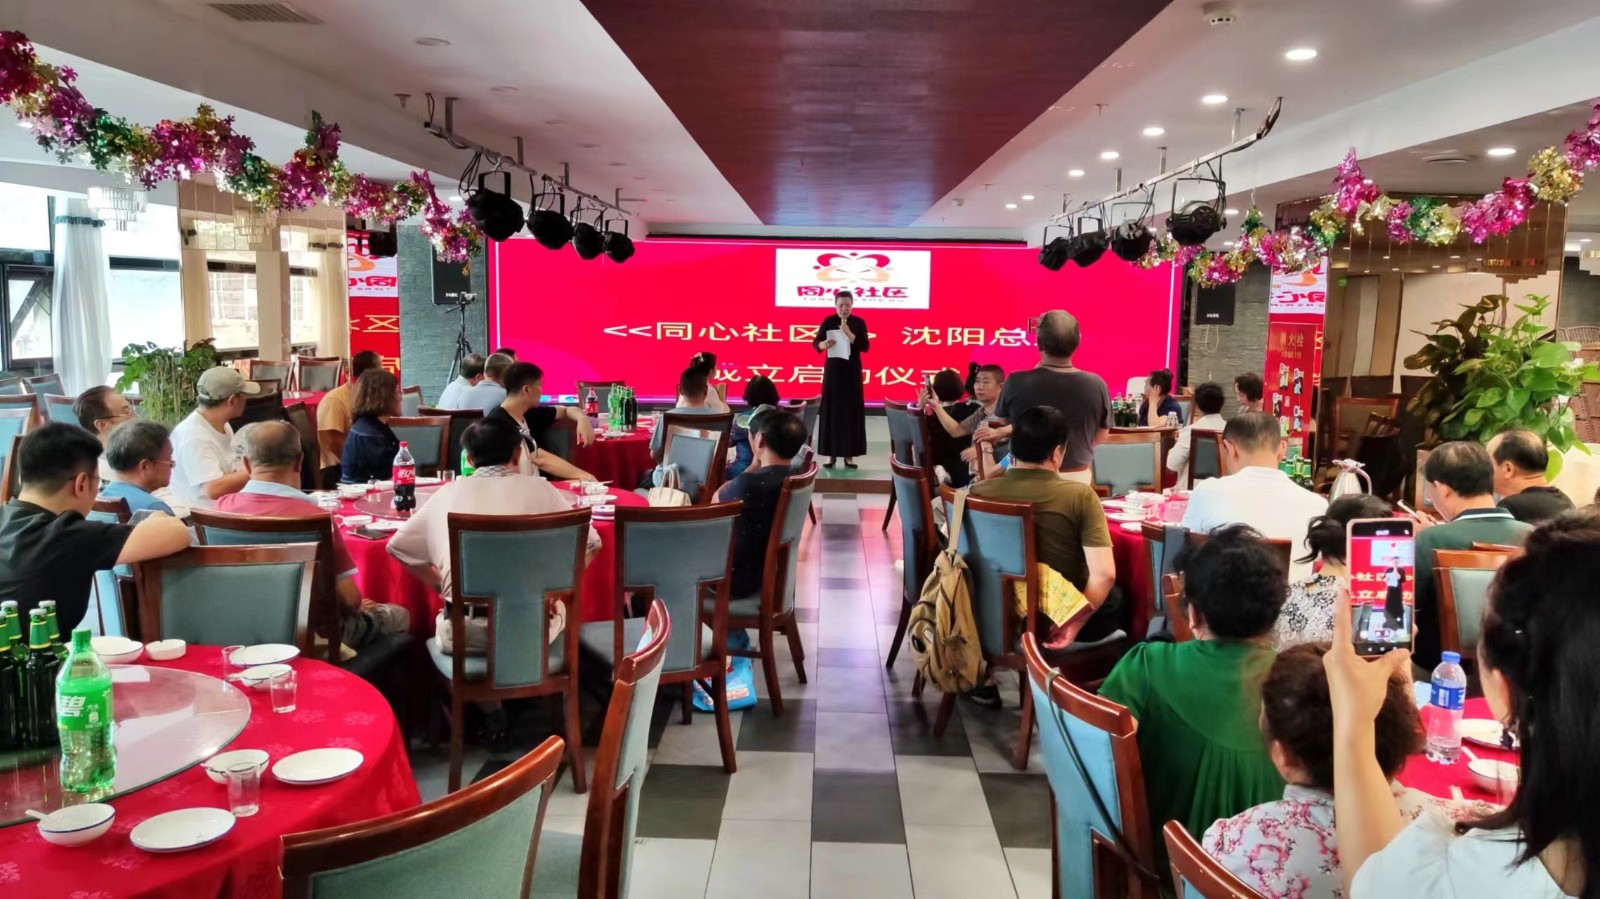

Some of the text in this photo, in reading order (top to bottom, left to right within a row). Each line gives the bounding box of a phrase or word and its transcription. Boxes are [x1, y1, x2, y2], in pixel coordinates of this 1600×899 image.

[604, 321, 1037, 346] <<同心社区 沈阳总
